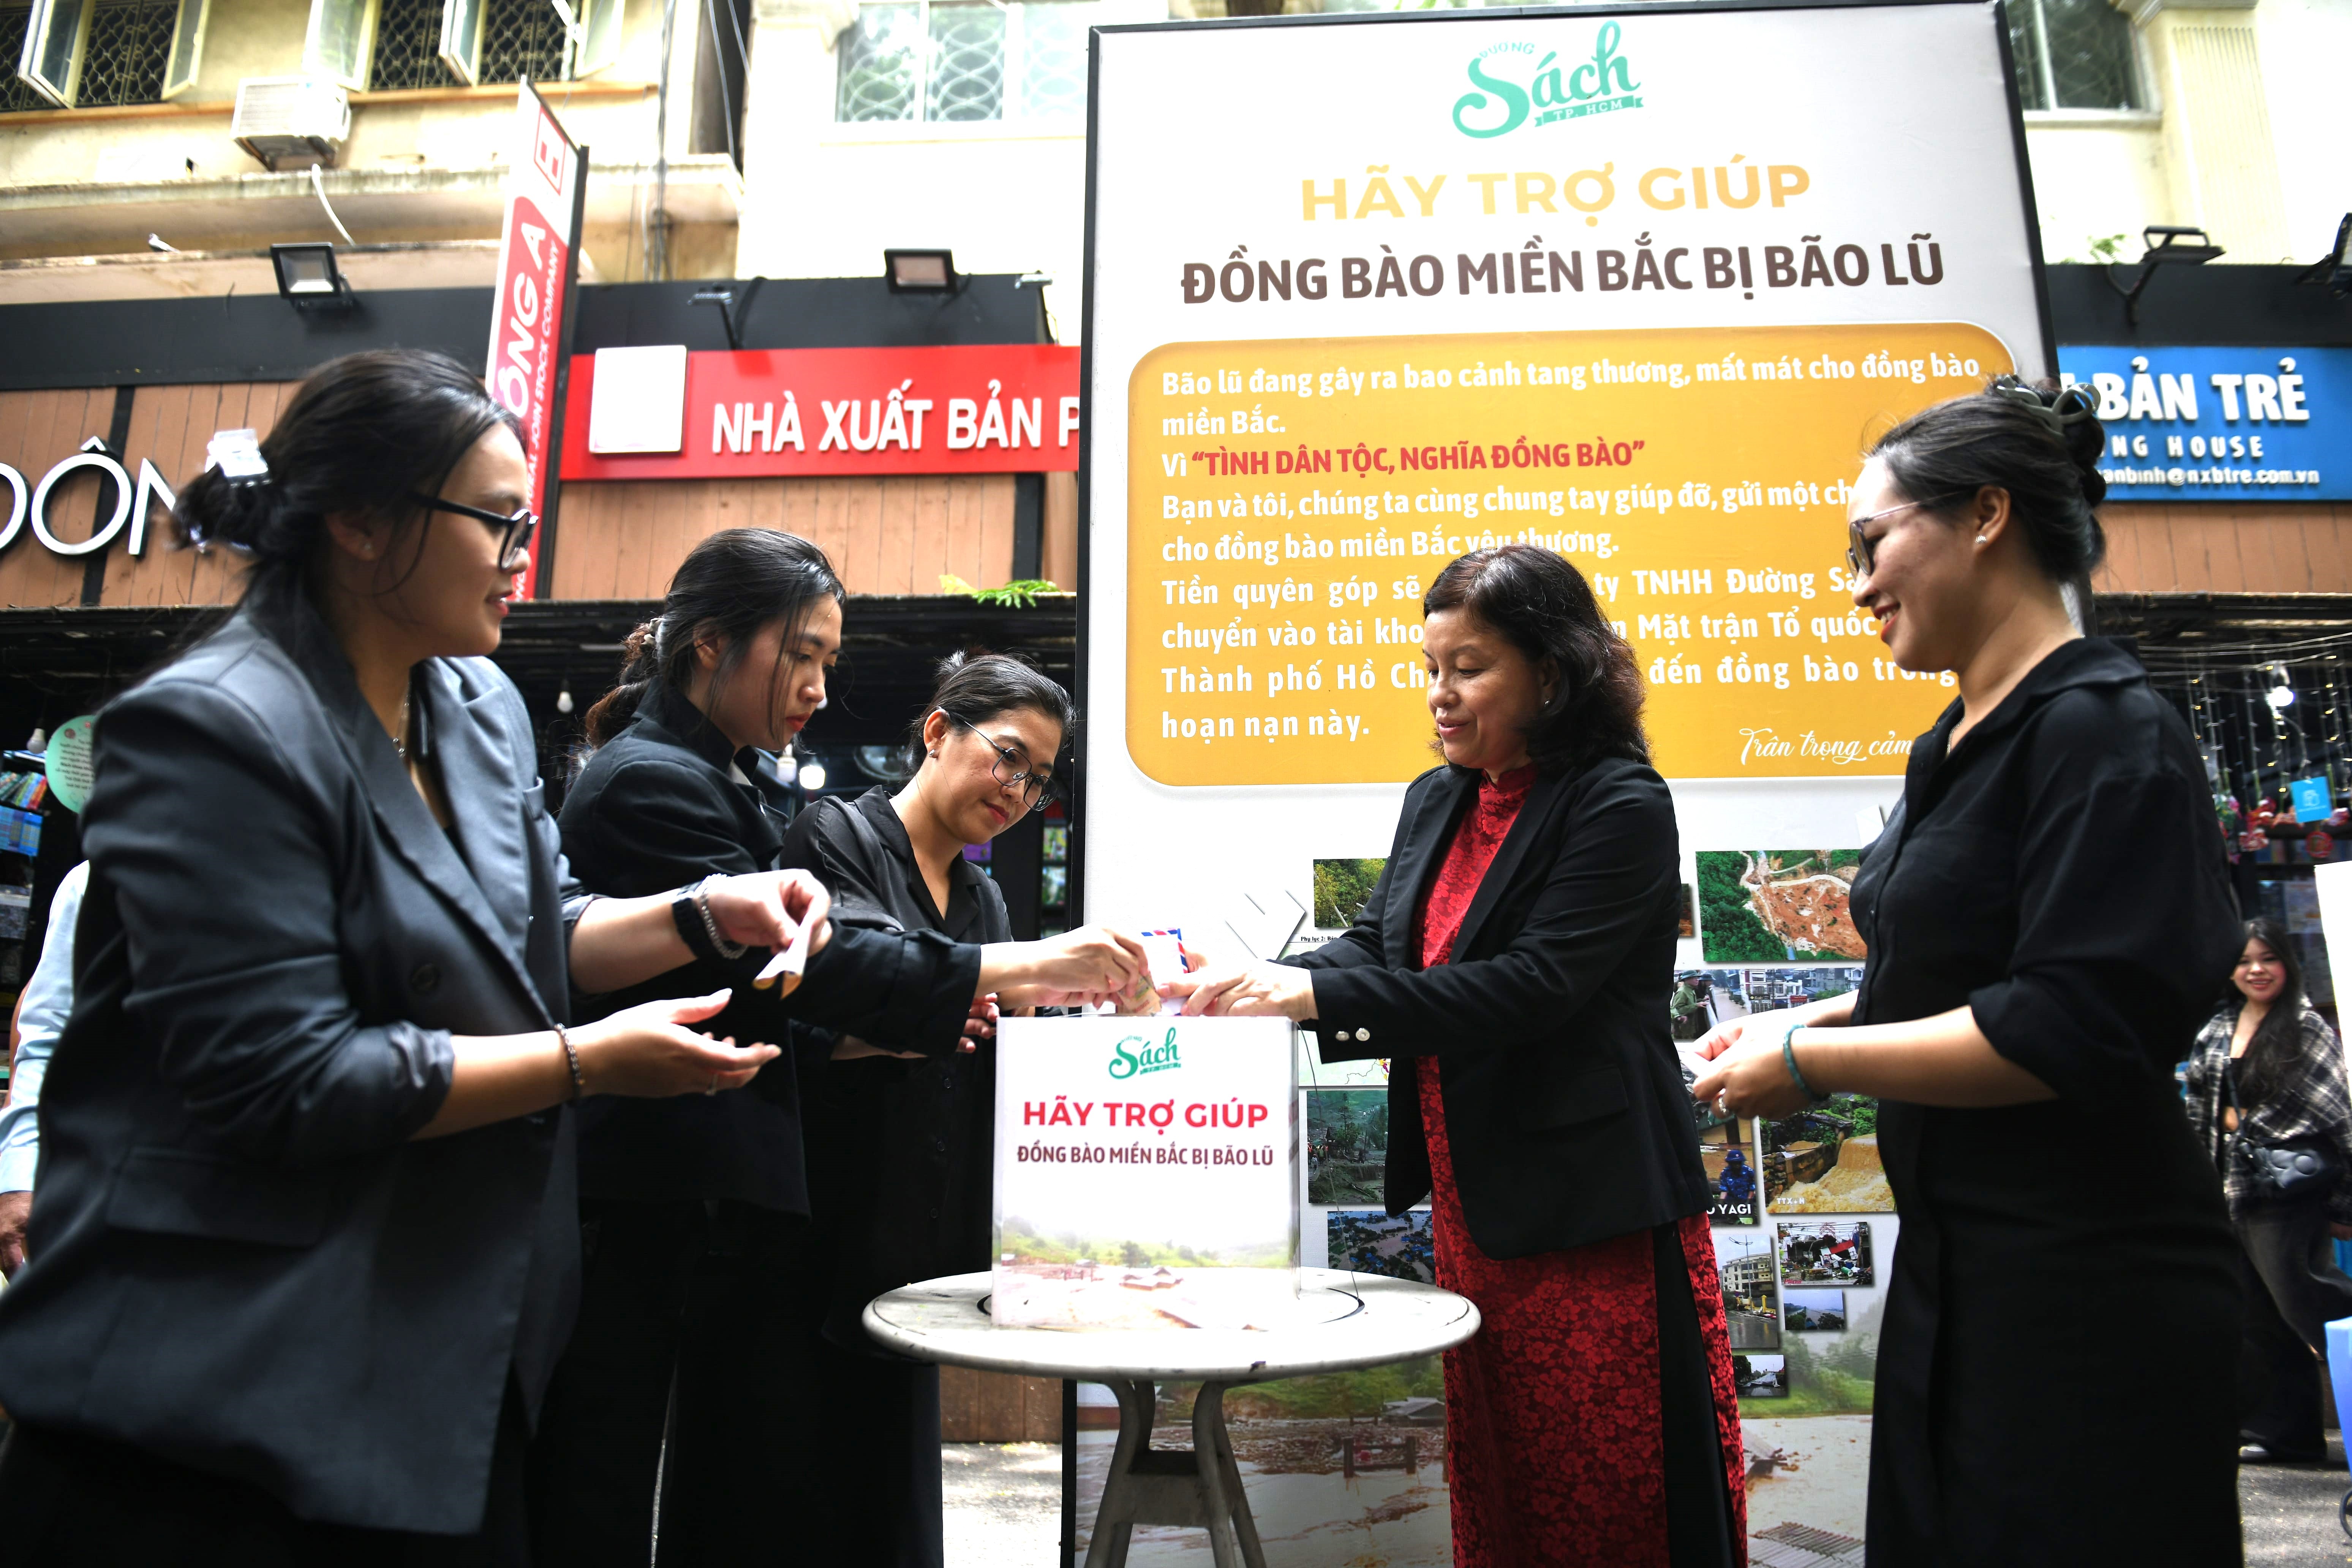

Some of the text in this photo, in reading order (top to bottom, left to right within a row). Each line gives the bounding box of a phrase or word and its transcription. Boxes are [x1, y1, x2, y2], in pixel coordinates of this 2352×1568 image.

[1452, 20, 1641, 139] Sách
[1586, 100, 1623, 115] HCM
[1302, 154, 1810, 227] HÃY TRỢ GIÚP
[542, 242, 559, 337] COMPANY
[1181, 232, 1943, 303] ĐỒNG BÀO MIỀN BẮC BỊ BÃO LŨ
[498, 222, 546, 417] ÔNG A
[535, 339, 550, 401] STOCK
[1163, 350, 1979, 397] Bão lũ đang gây ra bao cảnh tang thương, mất mát cho đồng bào
[2092, 356, 2309, 420] BẢN TRẺ
[712, 390, 805, 453] NHÀ
[819, 379, 933, 450] XUẤT
[947, 379, 1042, 448] BẢN
[1163, 404, 1285, 435] miền Bắc.
[1162, 436, 1644, 477] Vì “TÌNH DÂN TỘC, NGHĨA ĐỒNG BÀO”
[2168, 436, 2263, 457] HOUSE
[1163, 479, 1852, 524] Bạn và tôi, chúng ta cùng chung tay giúp đỡ, gửi một ch
[1163, 536, 1208, 561] cho
[1215, 531, 1279, 565] đồng
[1285, 533, 1333, 558] bào
[1340, 527, 1404, 557] miền
[1412, 524, 1460, 555] Bắc
[1162, 575, 1217, 604] Tiền
[1234, 577, 1313, 609] quyên
[1329, 575, 1377, 607] góp
[1393, 575, 1420, 599] sẽ
[1594, 573, 1619, 602] ty
[1632, 570, 1712, 594] TNHH
[1727, 567, 1815, 599] Đường
[1162, 616, 1256, 654] chuyển
[1268, 621, 1315, 646] vào
[1327, 620, 1362, 645] tài
[1375, 617, 1424, 643] kho
[1639, 614, 1690, 645] Mặt
[1701, 613, 1758, 644] trận
[1768, 606, 1799, 636] Tổ
[1810, 606, 1877, 643] quốc
[1162, 665, 1252, 692] Thành
[1269, 659, 1322, 697] phố
[1337, 659, 1375, 689] Hồ
[1391, 661, 1424, 688] Ch
[1650, 653, 1701, 684] đến
[1718, 652, 1789, 689] đồng
[1804, 655, 1858, 681] bào
[1163, 709, 1369, 744] hoạn nạn này.
[1739, 728, 1912, 765] Trân trọng cảm
[1108, 1026, 1181, 1080] Sách
[1024, 1096, 1093, 1125] HÃY
[1103, 1099, 1174, 1135] TRỢ
[1185, 1098, 1267, 1127] GIÚP
[1018, 1140, 1066, 1162] ĐỒNG
[1071, 1142, 1105, 1163] BÀO
[1110, 1142, 1151, 1163] MIỀN
[1157, 1142, 1187, 1164] BẮC
[1193, 1149, 1208, 1170] BỊ
[1214, 1146, 1247, 1165] BÃO
[1253, 1146, 1272, 1165] LŨ
[1718, 1204, 1751, 1214] YAGI
